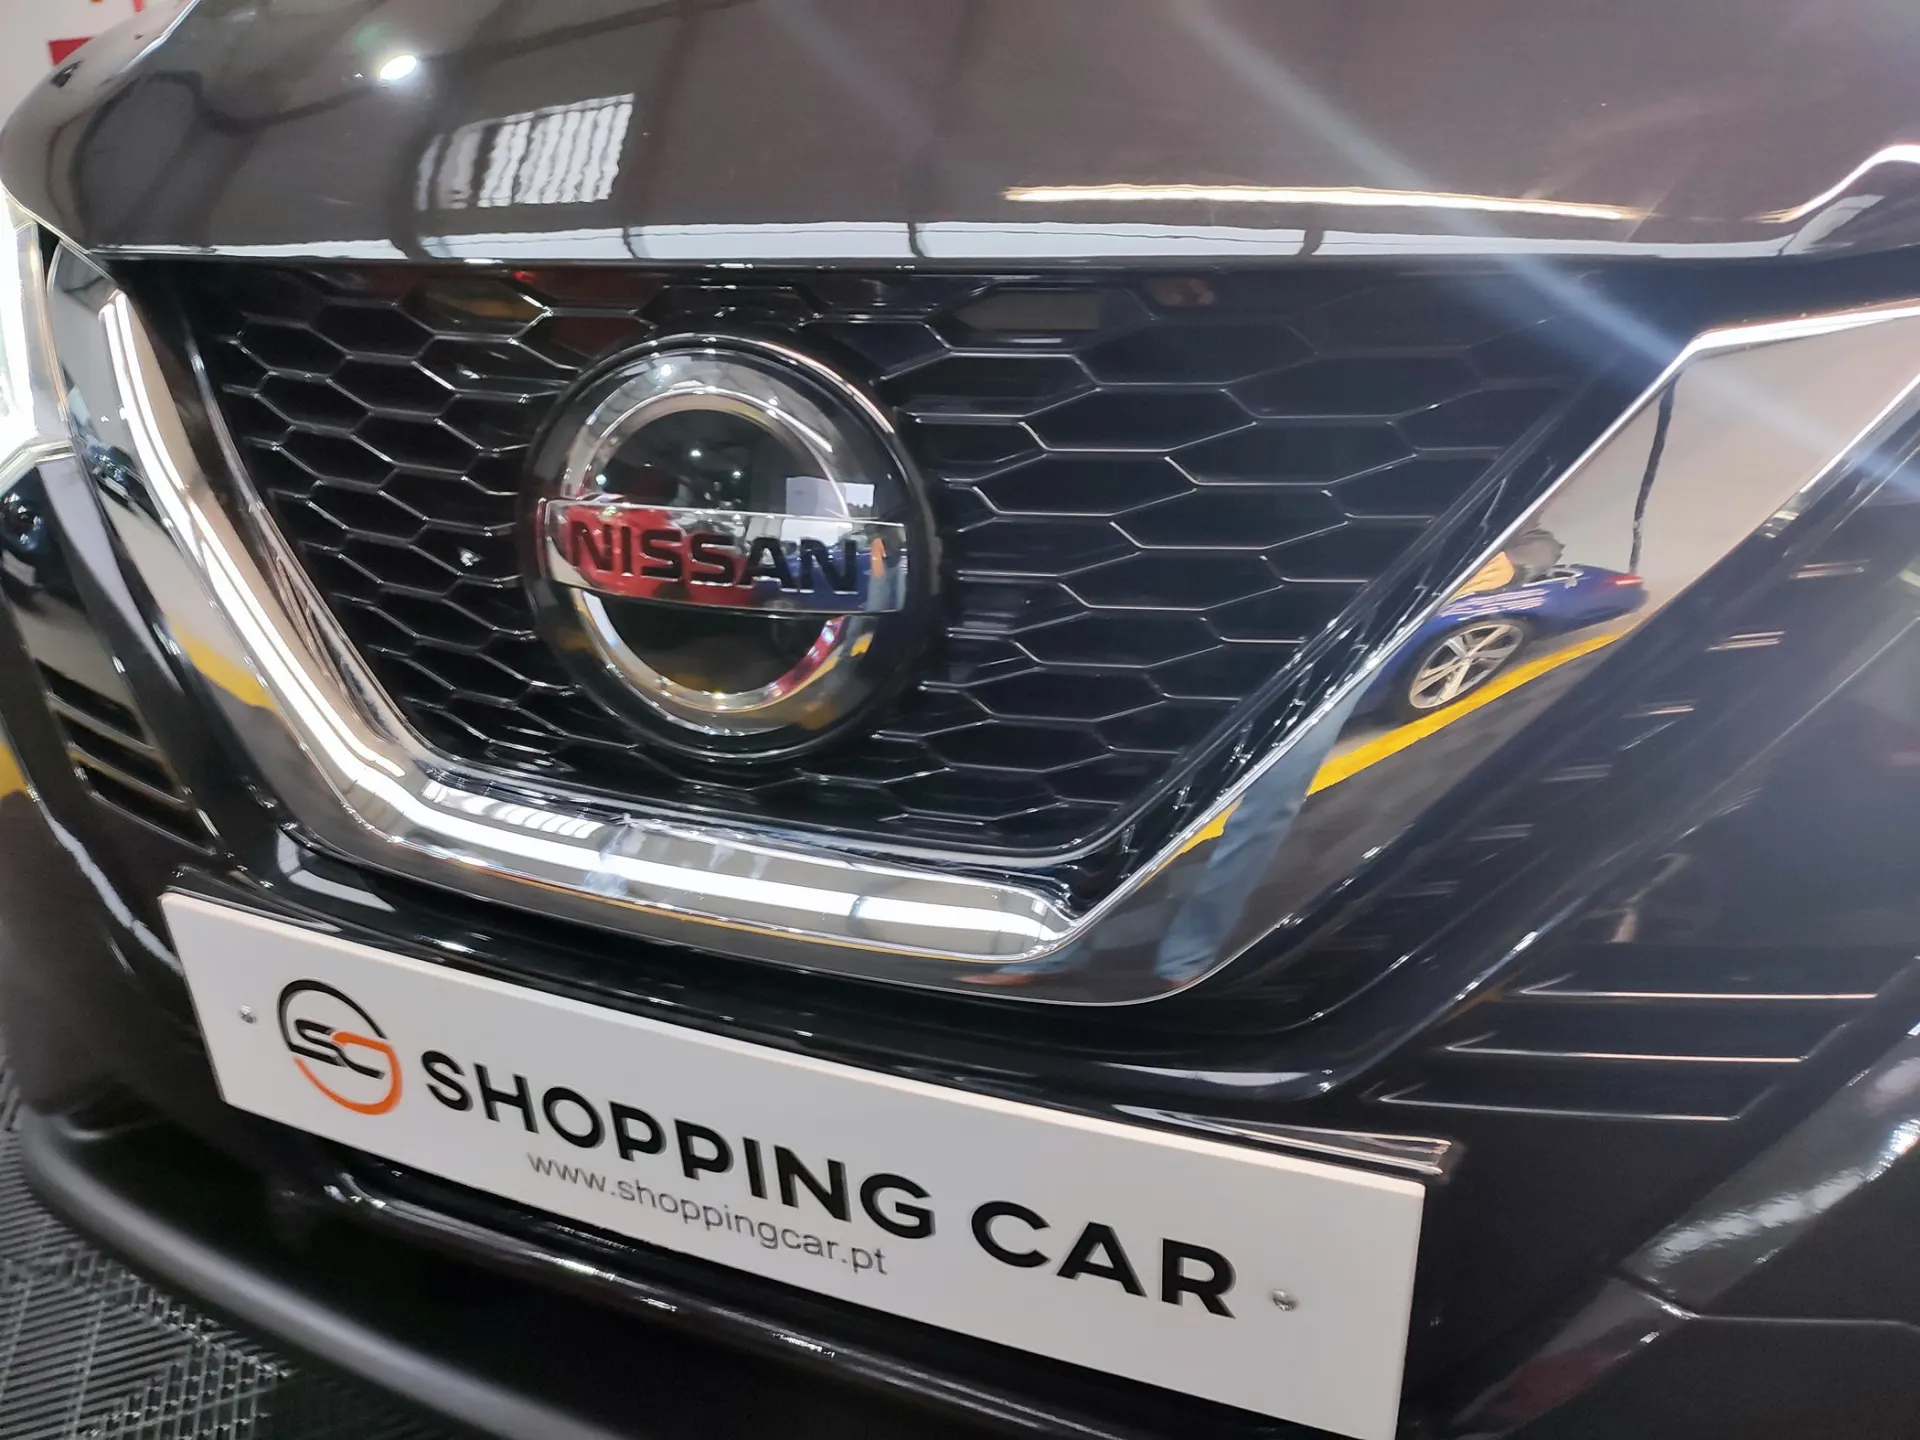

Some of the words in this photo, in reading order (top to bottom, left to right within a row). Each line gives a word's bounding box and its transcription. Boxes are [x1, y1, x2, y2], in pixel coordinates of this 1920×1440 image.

[568, 520, 859, 595] NISSAN
[420, 1050, 936, 1240] SHOPPING
[971, 1200, 1237, 1320] CAR
[526, 1152, 888, 1276] www.shoppingcar.pt
